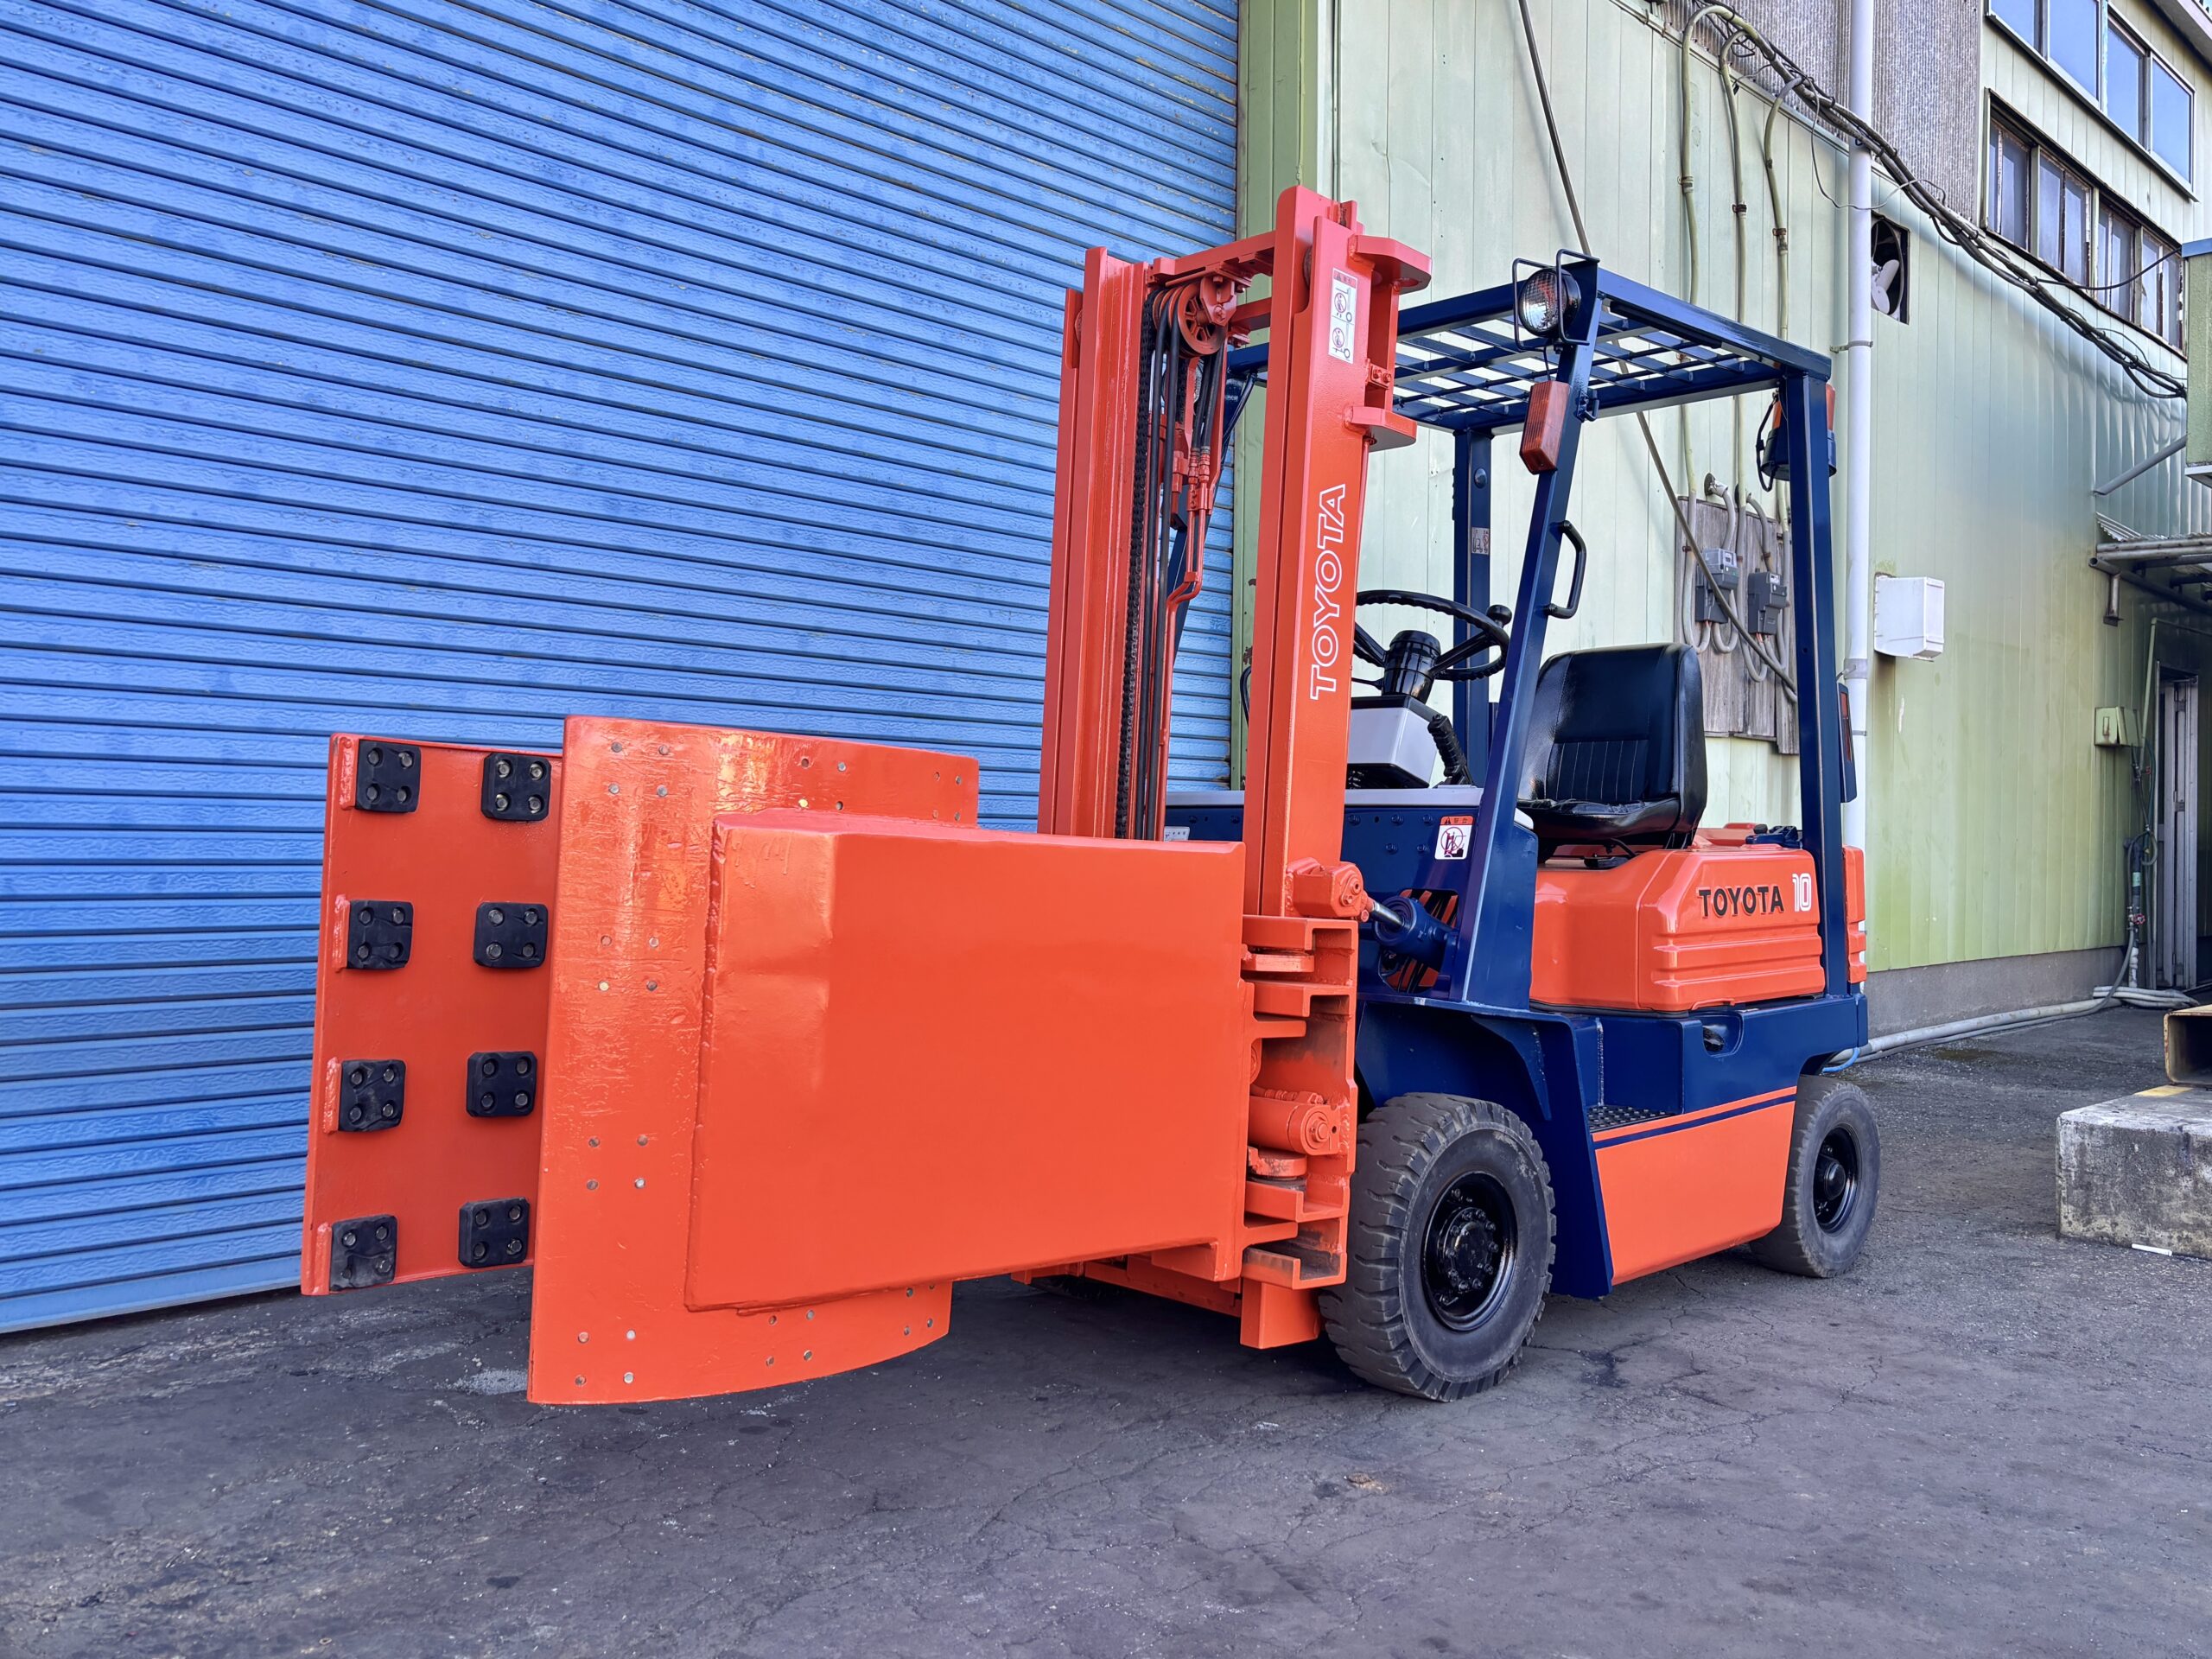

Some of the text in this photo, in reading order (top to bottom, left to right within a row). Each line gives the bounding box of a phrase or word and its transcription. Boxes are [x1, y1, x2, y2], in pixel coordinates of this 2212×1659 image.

[1310, 483, 1346, 700] TOYOTA
[1697, 873, 1812, 918] TOYOTA 10
